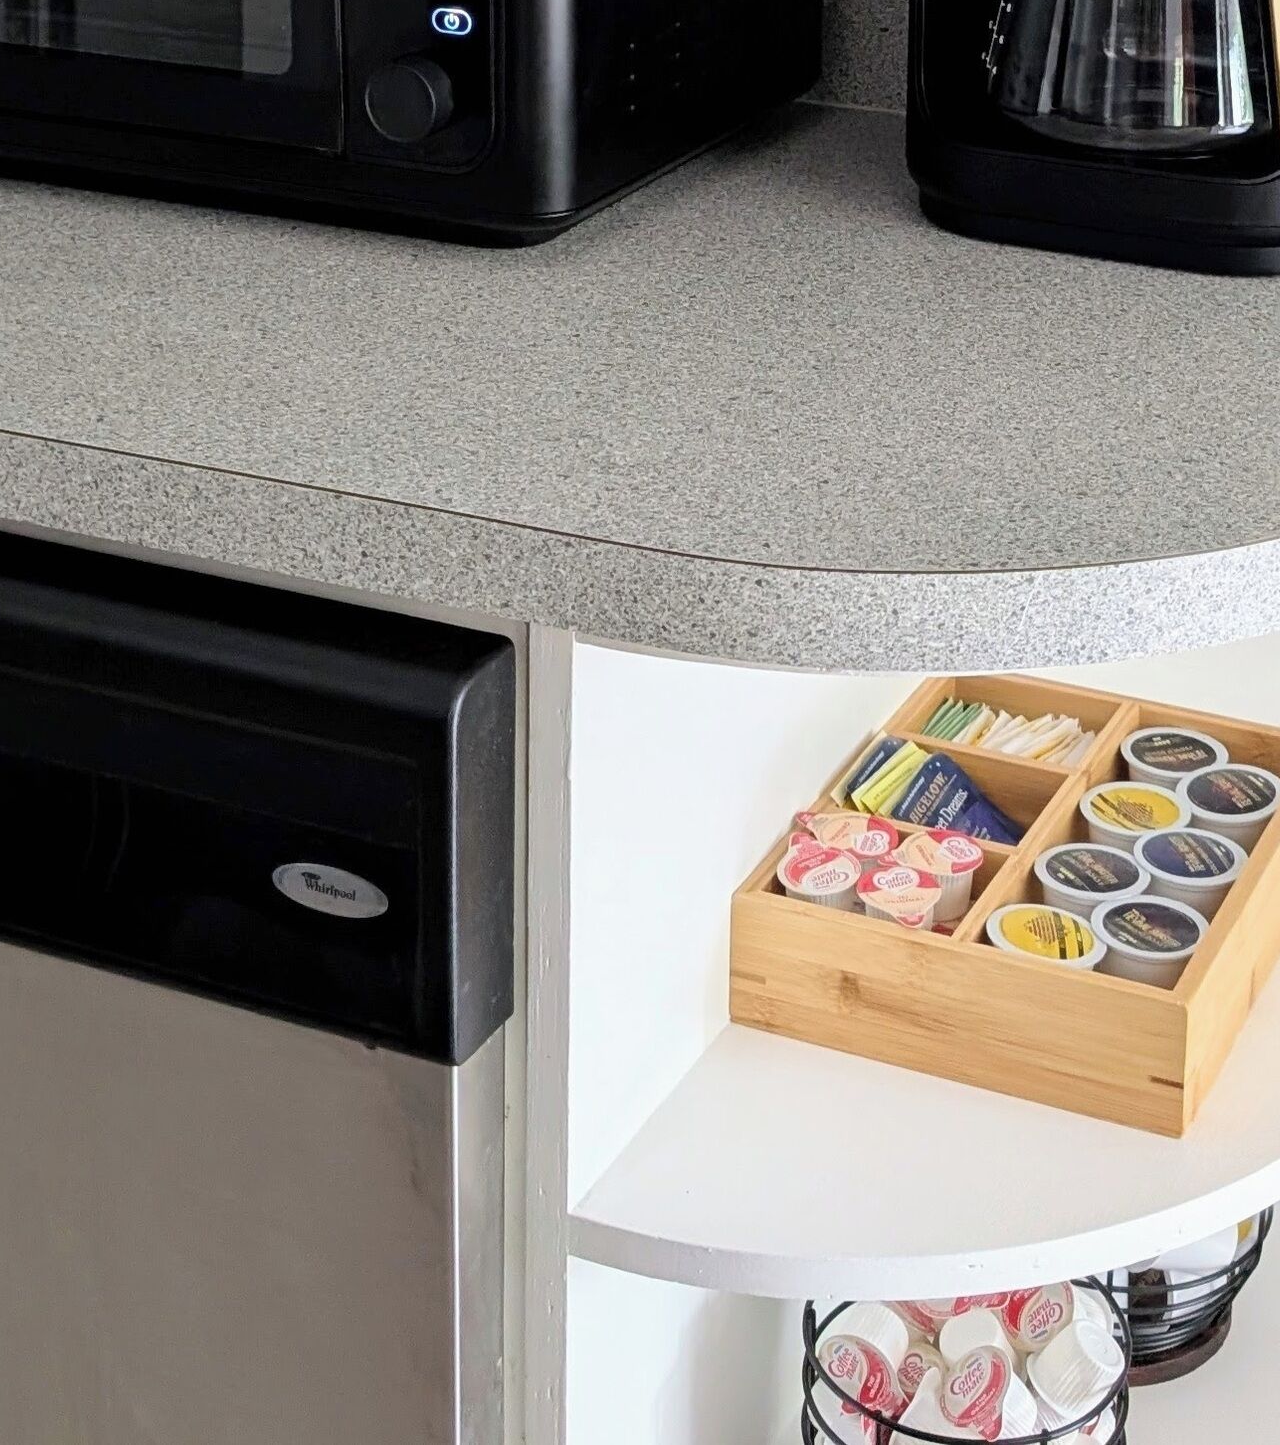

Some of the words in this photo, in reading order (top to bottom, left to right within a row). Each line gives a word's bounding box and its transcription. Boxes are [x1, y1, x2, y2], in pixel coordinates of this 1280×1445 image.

[302, 872, 356, 901] Whirlpool
[877, 873, 912, 886] Coffee
[1030, 1302, 1064, 1334] Coffee
[828, 1347, 852, 1378] Coffee
[950, 1361, 983, 1395] Coffee
[962, 1370, 985, 1399] mate
